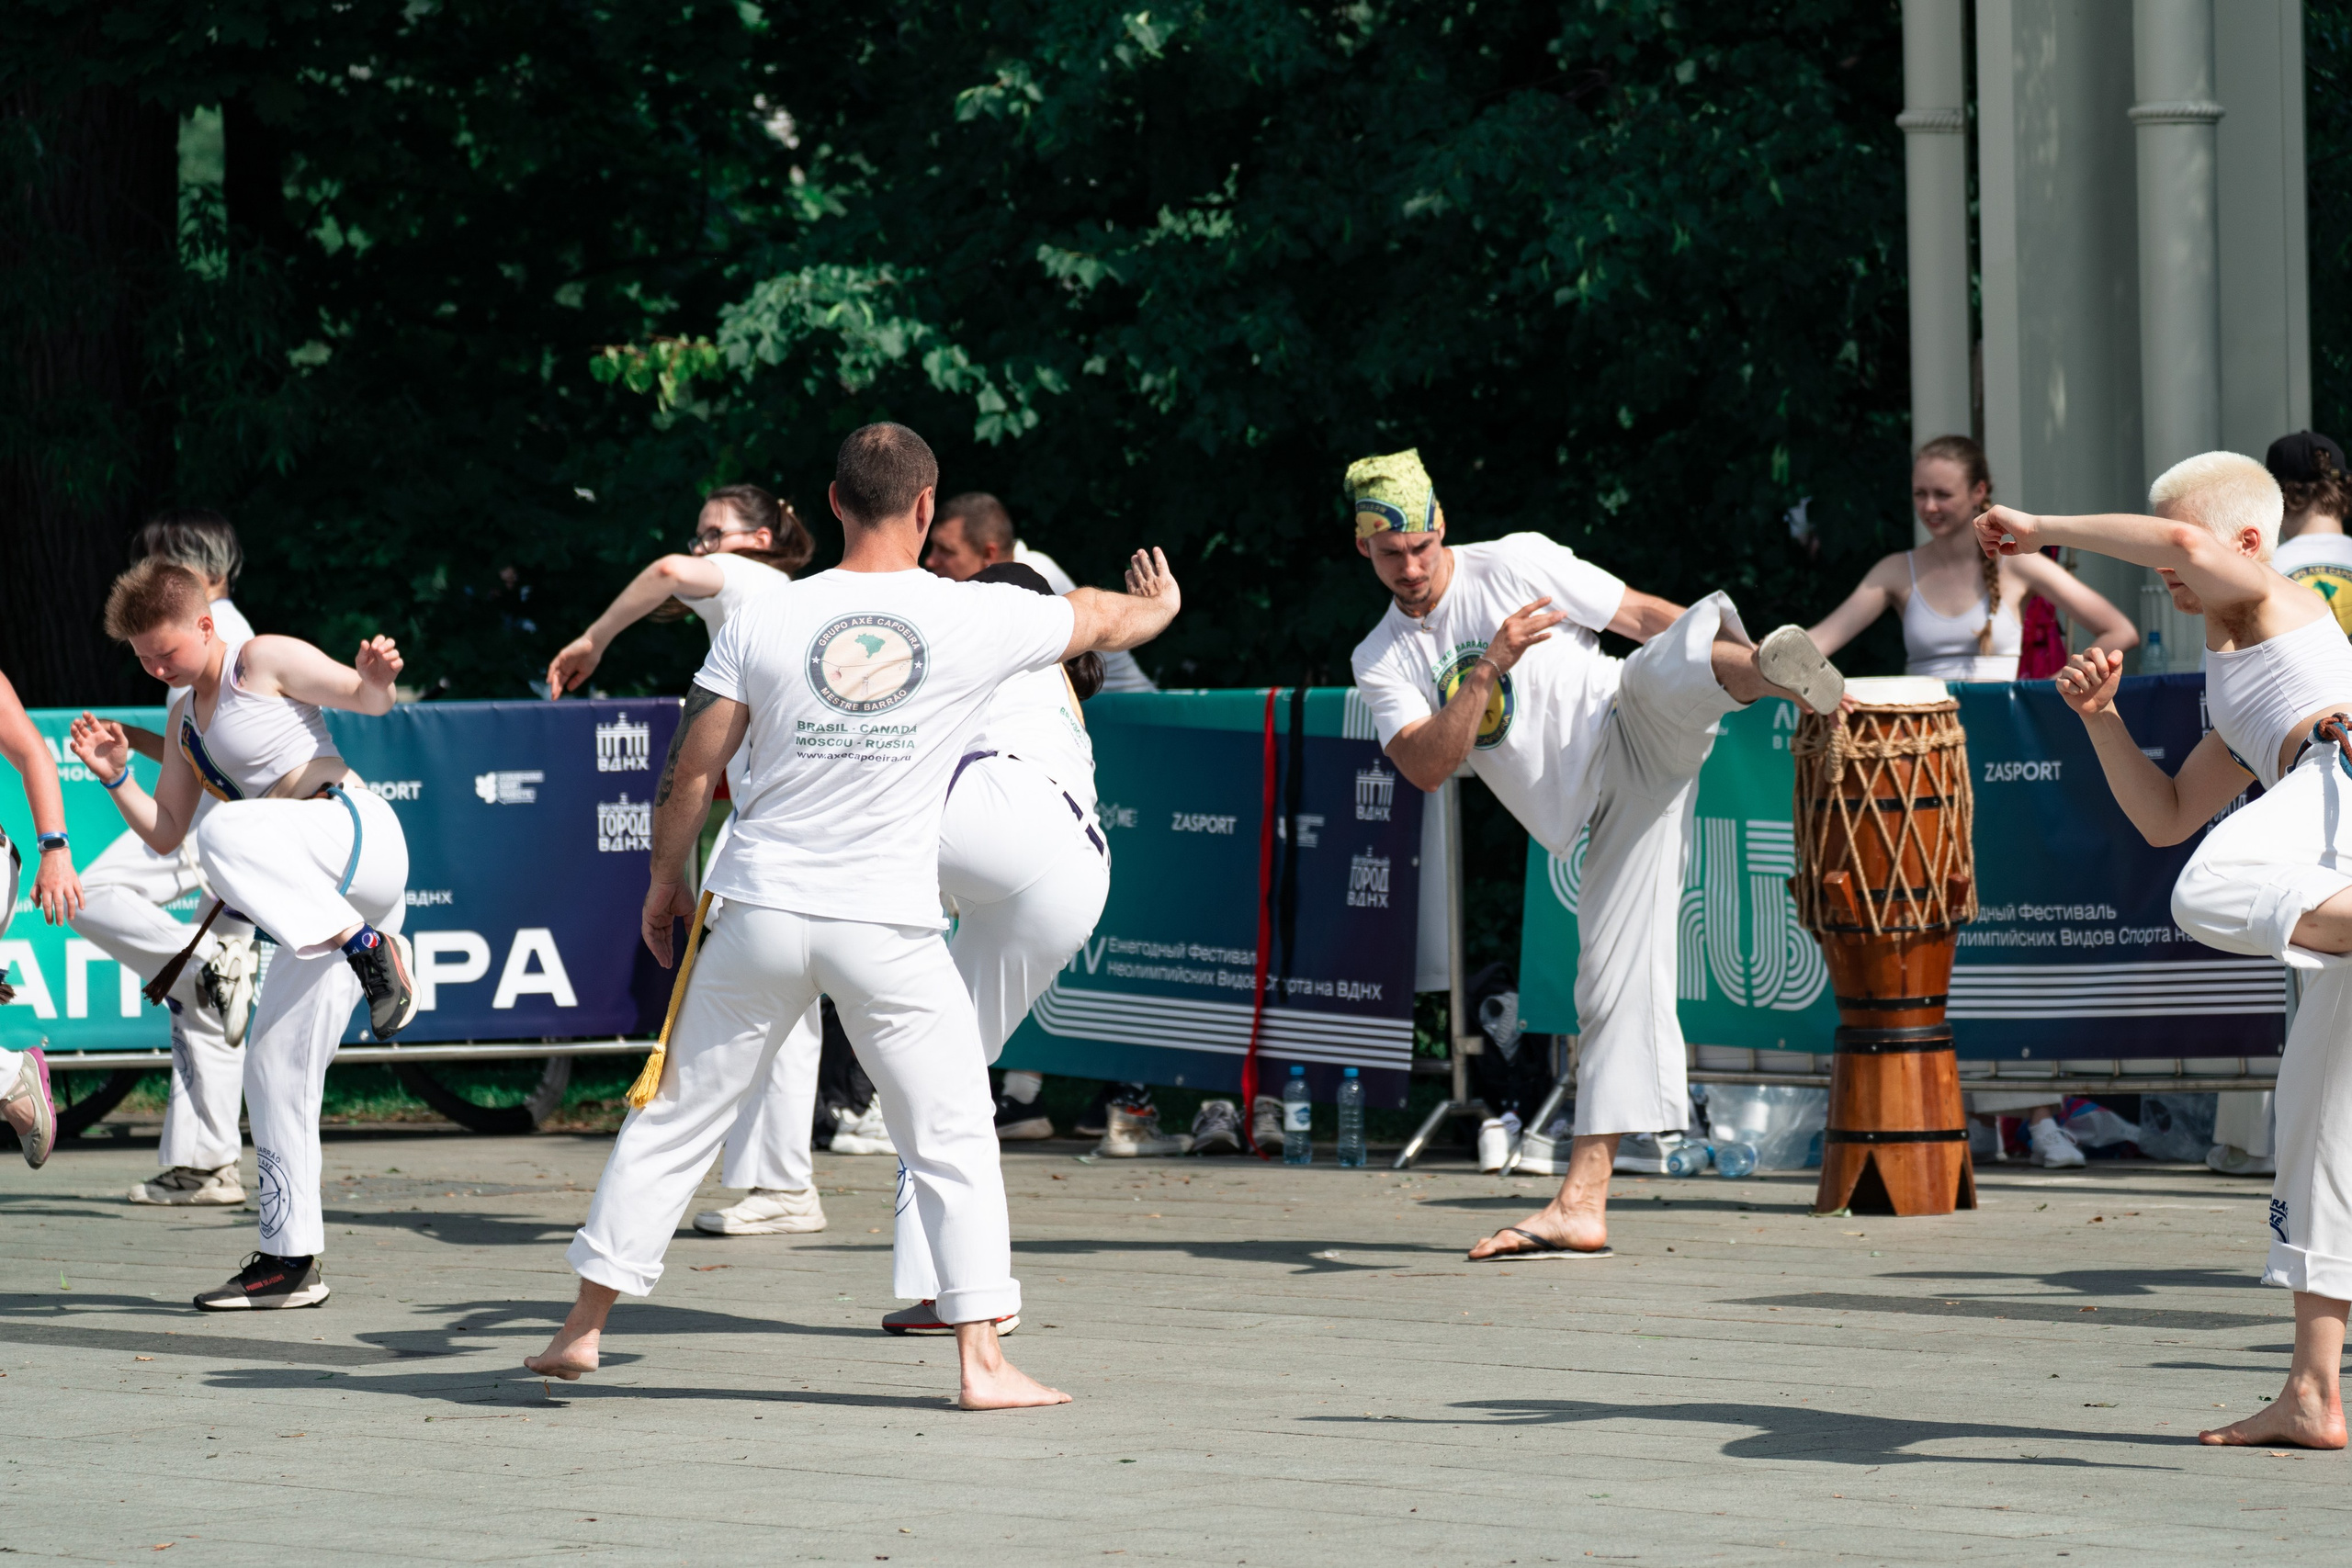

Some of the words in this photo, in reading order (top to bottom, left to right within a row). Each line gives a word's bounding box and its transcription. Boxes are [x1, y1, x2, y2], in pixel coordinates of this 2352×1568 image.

[818, 621, 848, 647] GRUPO
[851, 615, 873, 626] AXÉ
[876, 617, 922, 650] CAPOEIRA
[820, 686, 860, 711] MESTRE
[797, 720, 849, 732] BRASIL
[796, 736, 853, 748] MOSCOU
[597, 755, 650, 772] ВДНХ
[797, 751, 911, 762] www.axecapoeira.ru
[1984, 760, 2063, 783] ZASPORT
[366, 781, 423, 800] PORT
[1171, 810, 1238, 835] ZASPORT
[1356, 804, 1391, 822] ВДНХ
[598, 813, 651, 837] ГОРОД
[598, 835, 652, 852] ВДНХ
[1349, 865, 1390, 893] ГОРОД
[405, 889, 454, 907] ВДНХ
[1346, 889, 1389, 908] ВДНХ
[2018, 902, 2118, 921] Фестиваль
[1956, 927, 2057, 947] лимпийских
[2060, 927, 2114, 948] Видов
[2118, 925, 2171, 947] Спорта
[1107, 935, 1185, 960] Ежегодный
[1188, 942, 1259, 965] Фестивал
[1107, 960, 1215, 987] Неолимпийских
[1336, 981, 1383, 1001] ВДНХ
